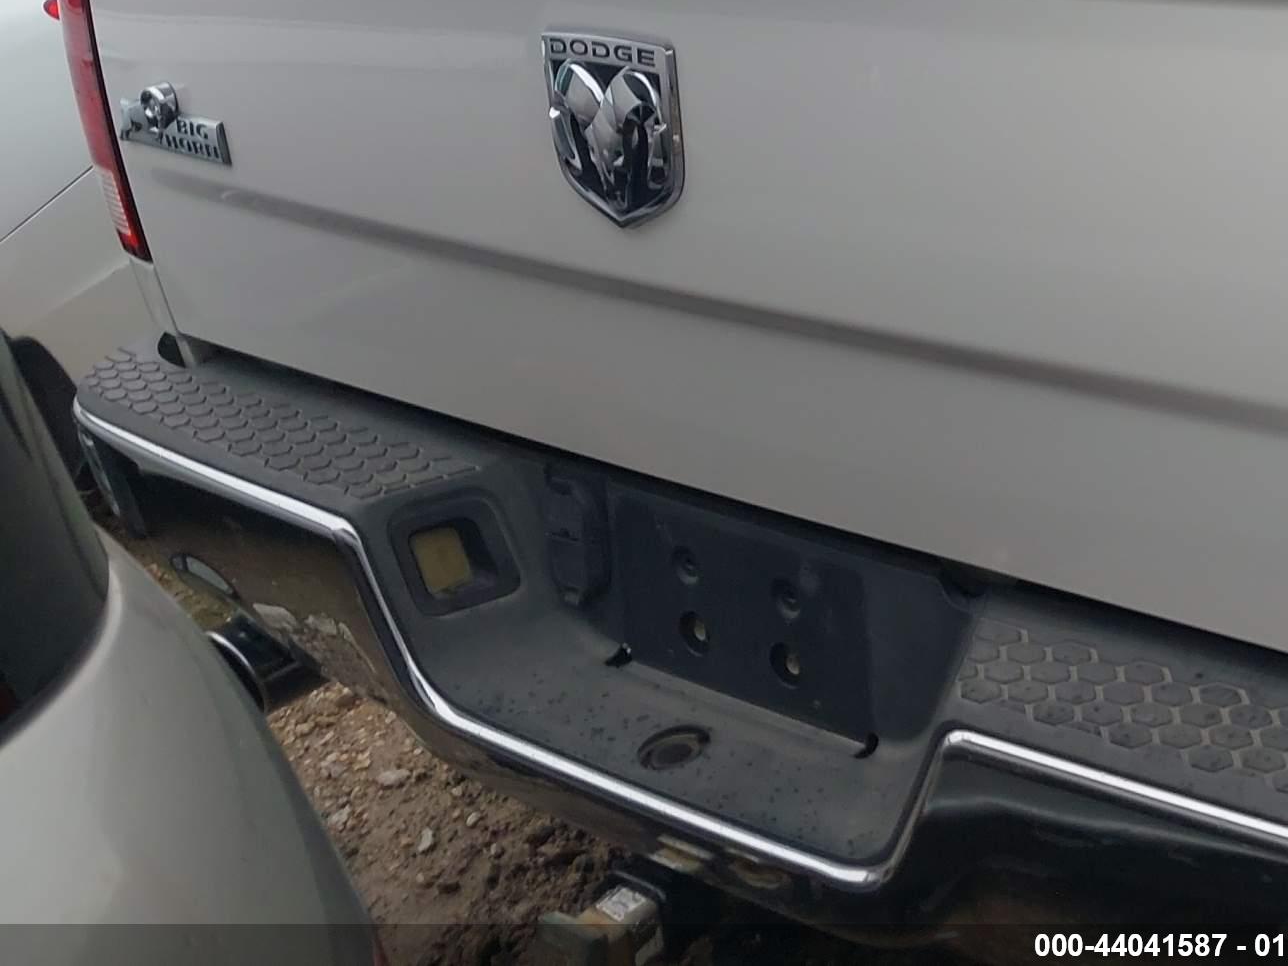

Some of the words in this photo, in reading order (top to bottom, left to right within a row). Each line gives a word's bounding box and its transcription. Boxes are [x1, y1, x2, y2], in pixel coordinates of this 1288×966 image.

[550, 37, 656, 67] DODGE
[176, 119, 209, 140] BIG
[165, 134, 220, 159] HORN
